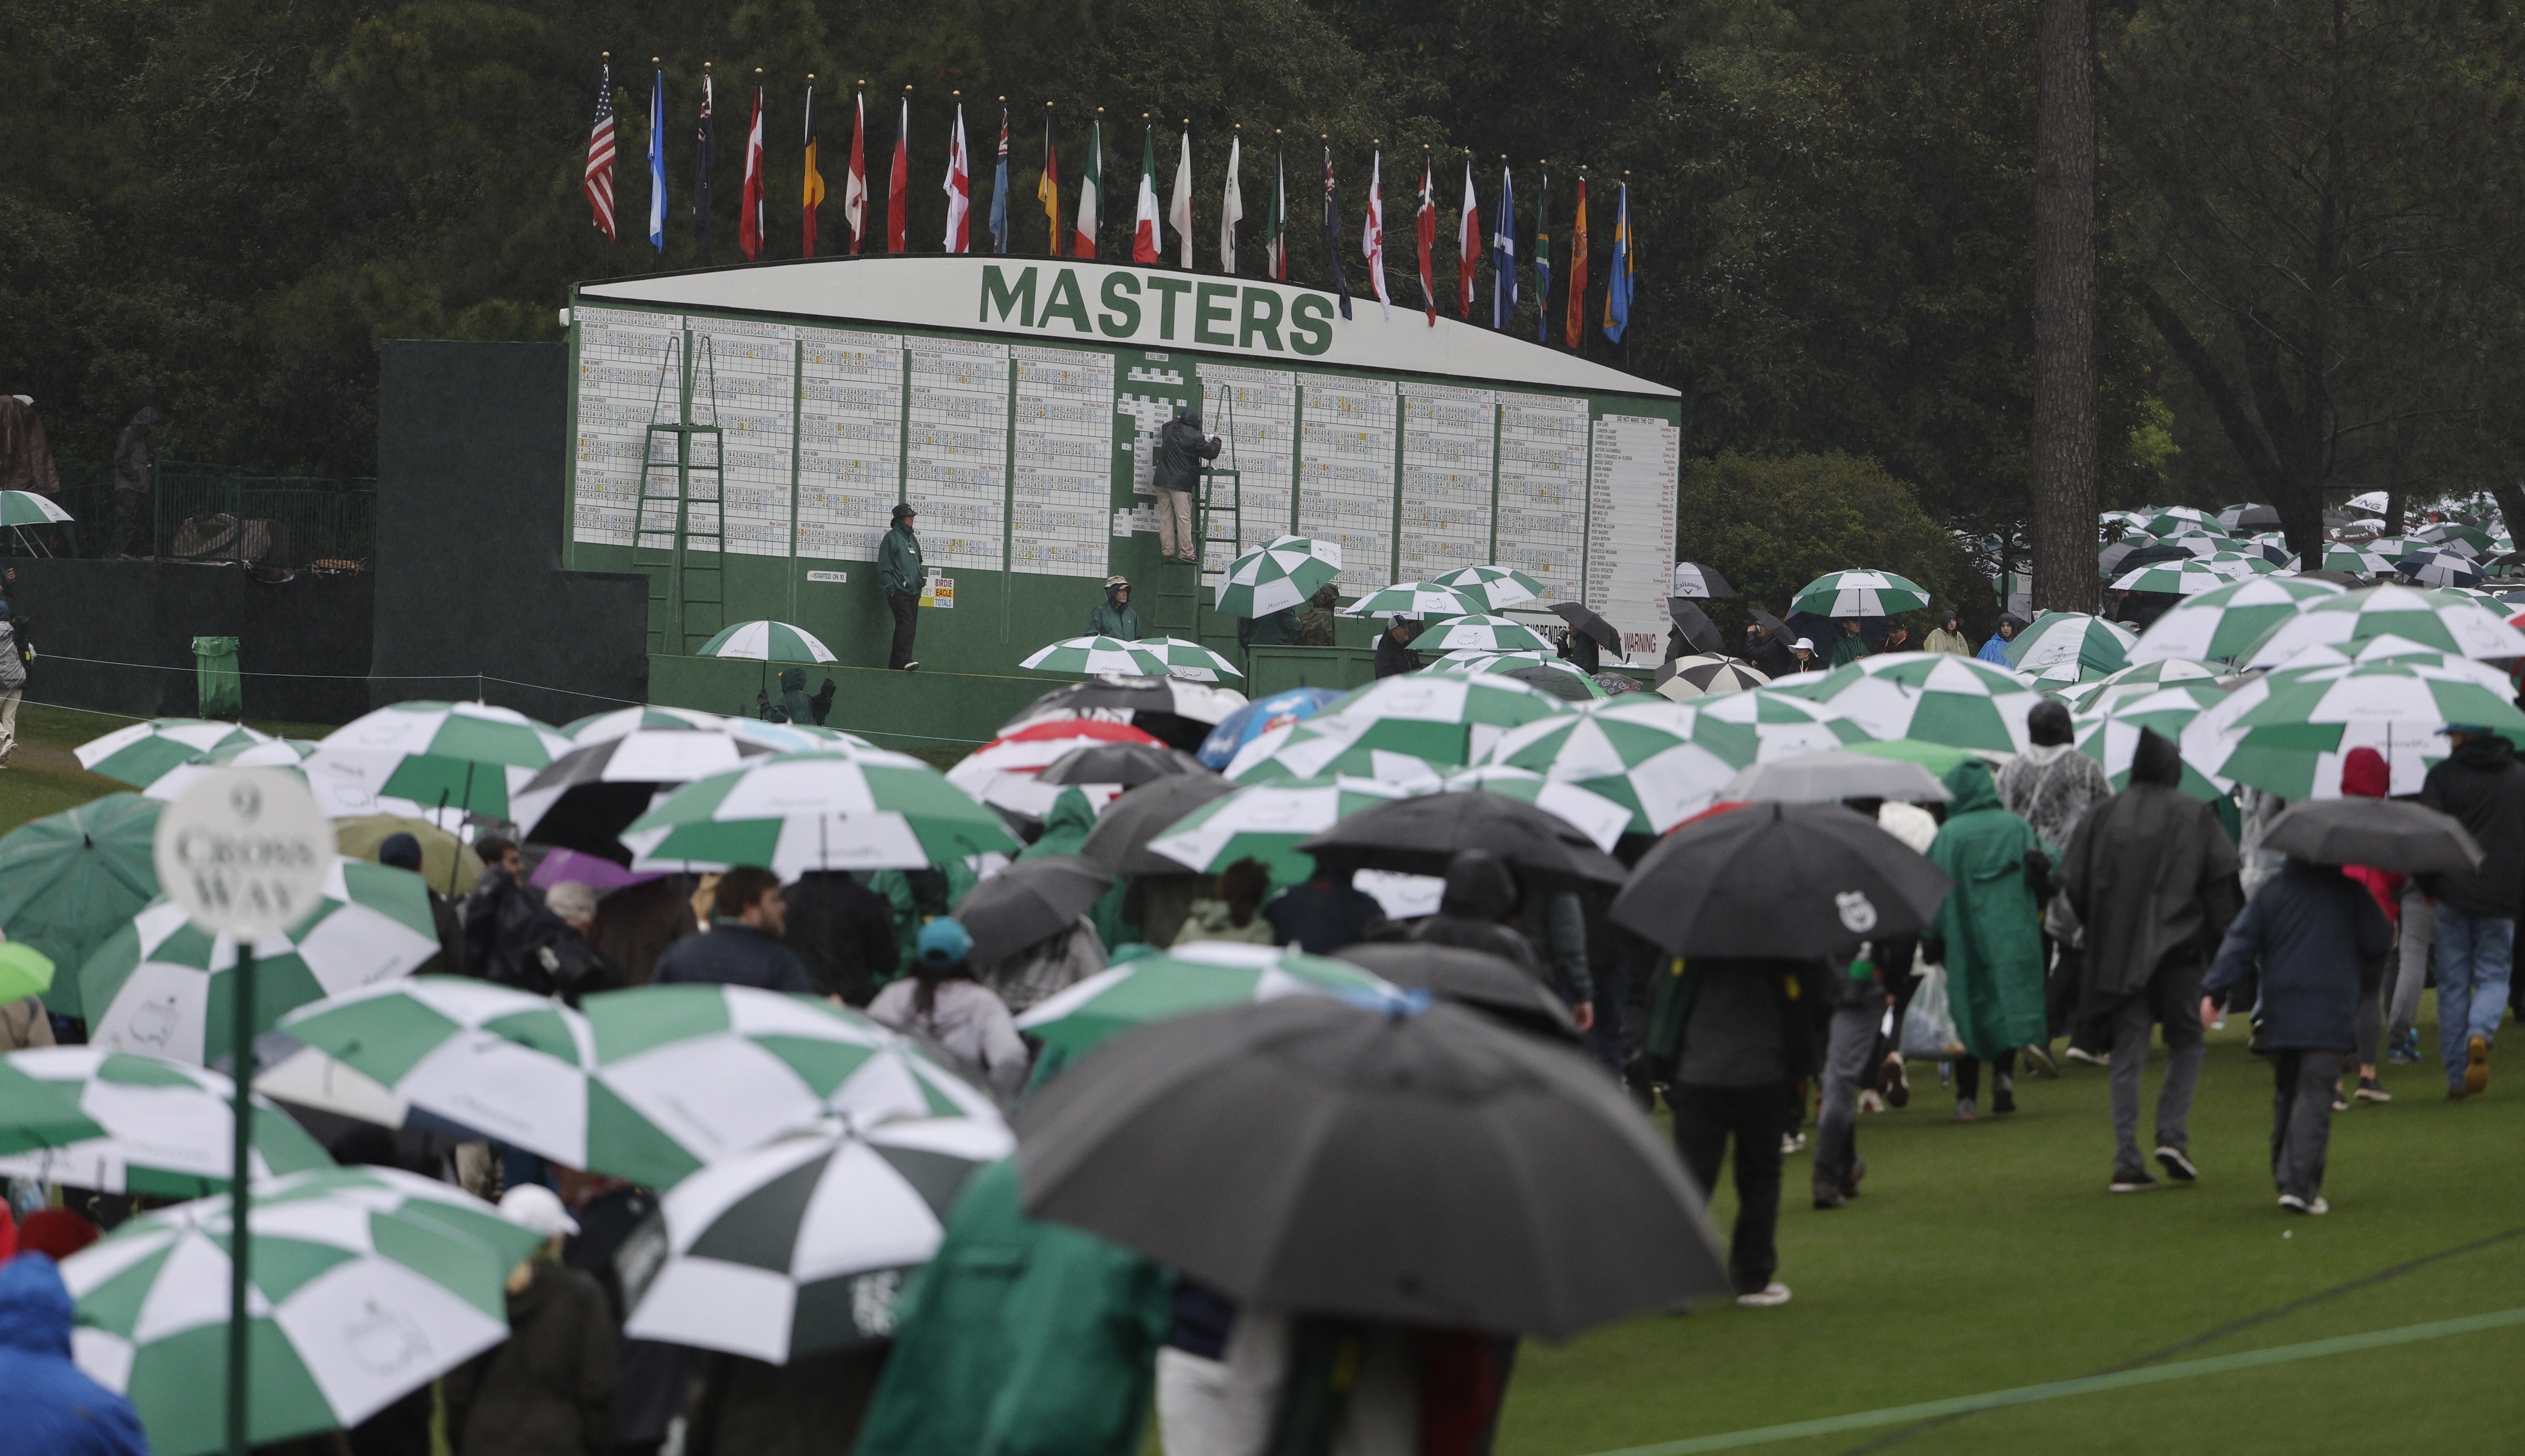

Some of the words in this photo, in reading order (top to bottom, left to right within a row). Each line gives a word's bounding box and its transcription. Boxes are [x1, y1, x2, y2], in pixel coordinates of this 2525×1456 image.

[979, 265, 1335, 356] MASTERS
[1675, 582, 1702, 590] Callaway
[1266, 599, 1289, 609] MASTERS
[1624, 632, 1656, 653] WARNING
